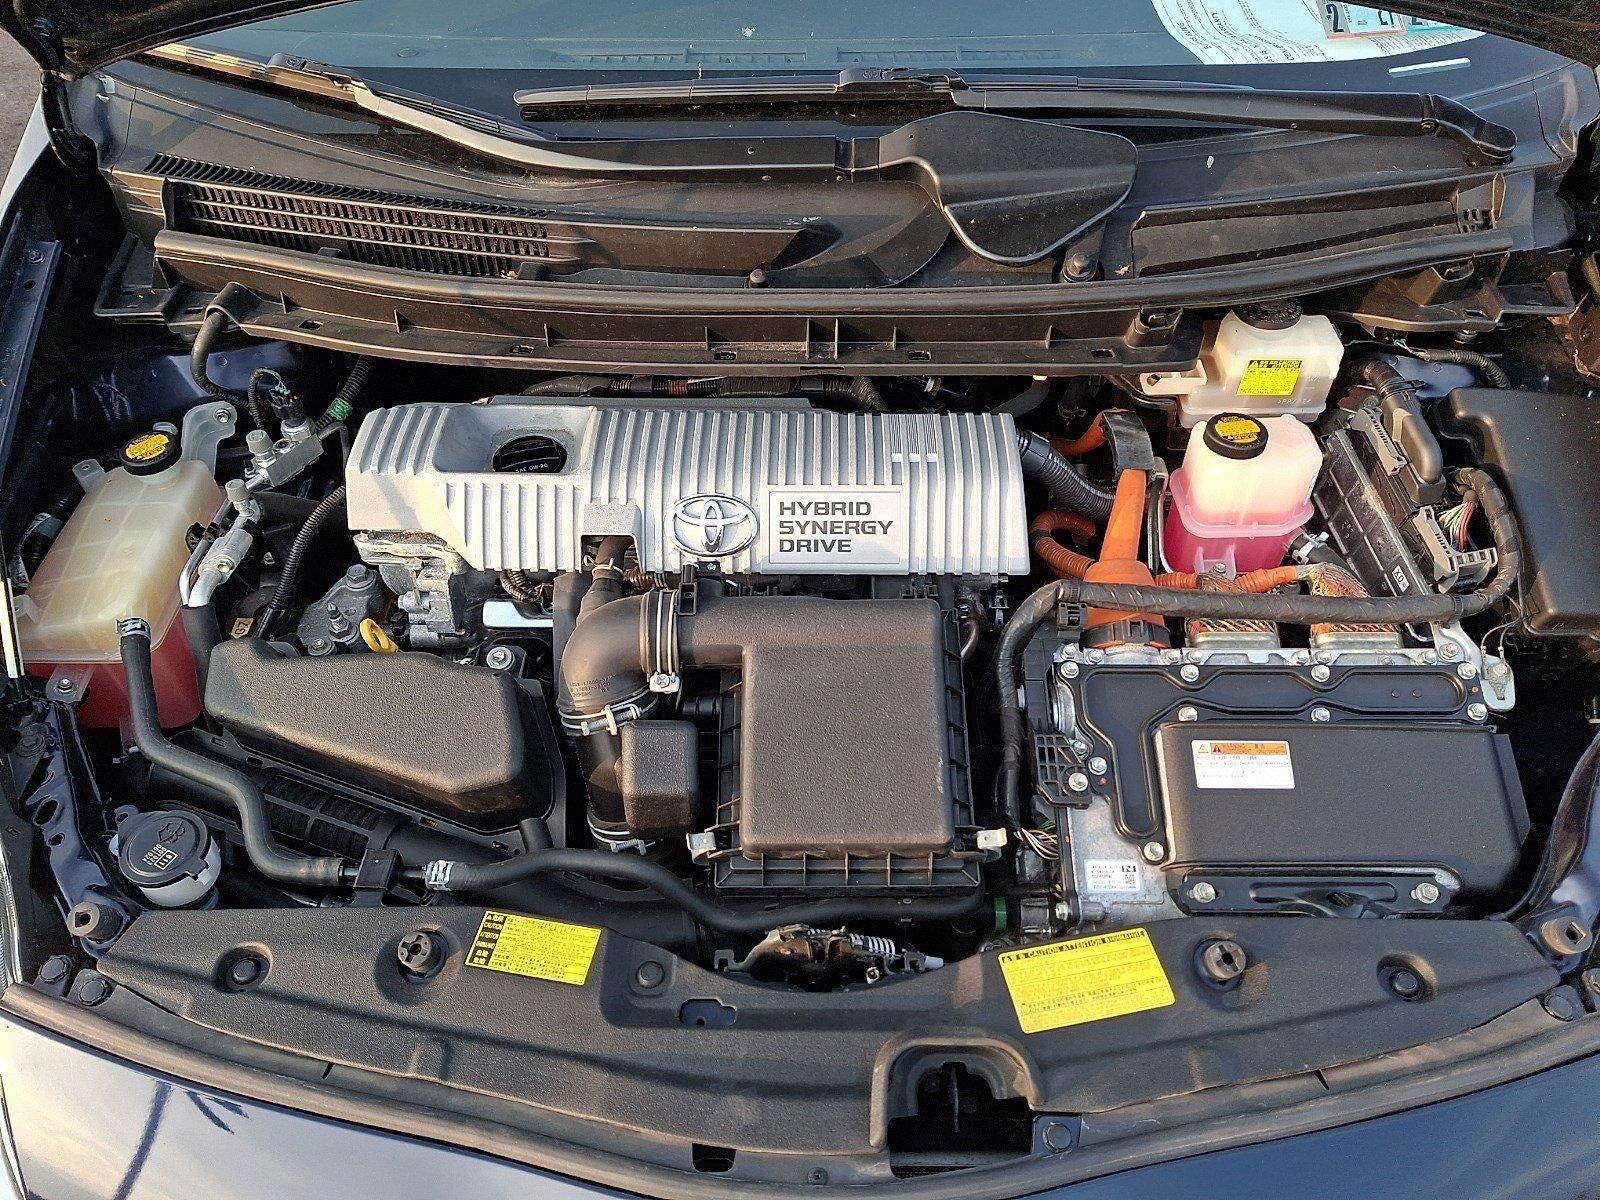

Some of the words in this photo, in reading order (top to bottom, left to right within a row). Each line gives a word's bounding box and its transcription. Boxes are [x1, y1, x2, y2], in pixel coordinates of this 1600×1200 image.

[779, 501, 871, 516] HYBRID
[779, 520, 893, 535] SYNERGY
[779, 538, 852, 553] DRIVE
